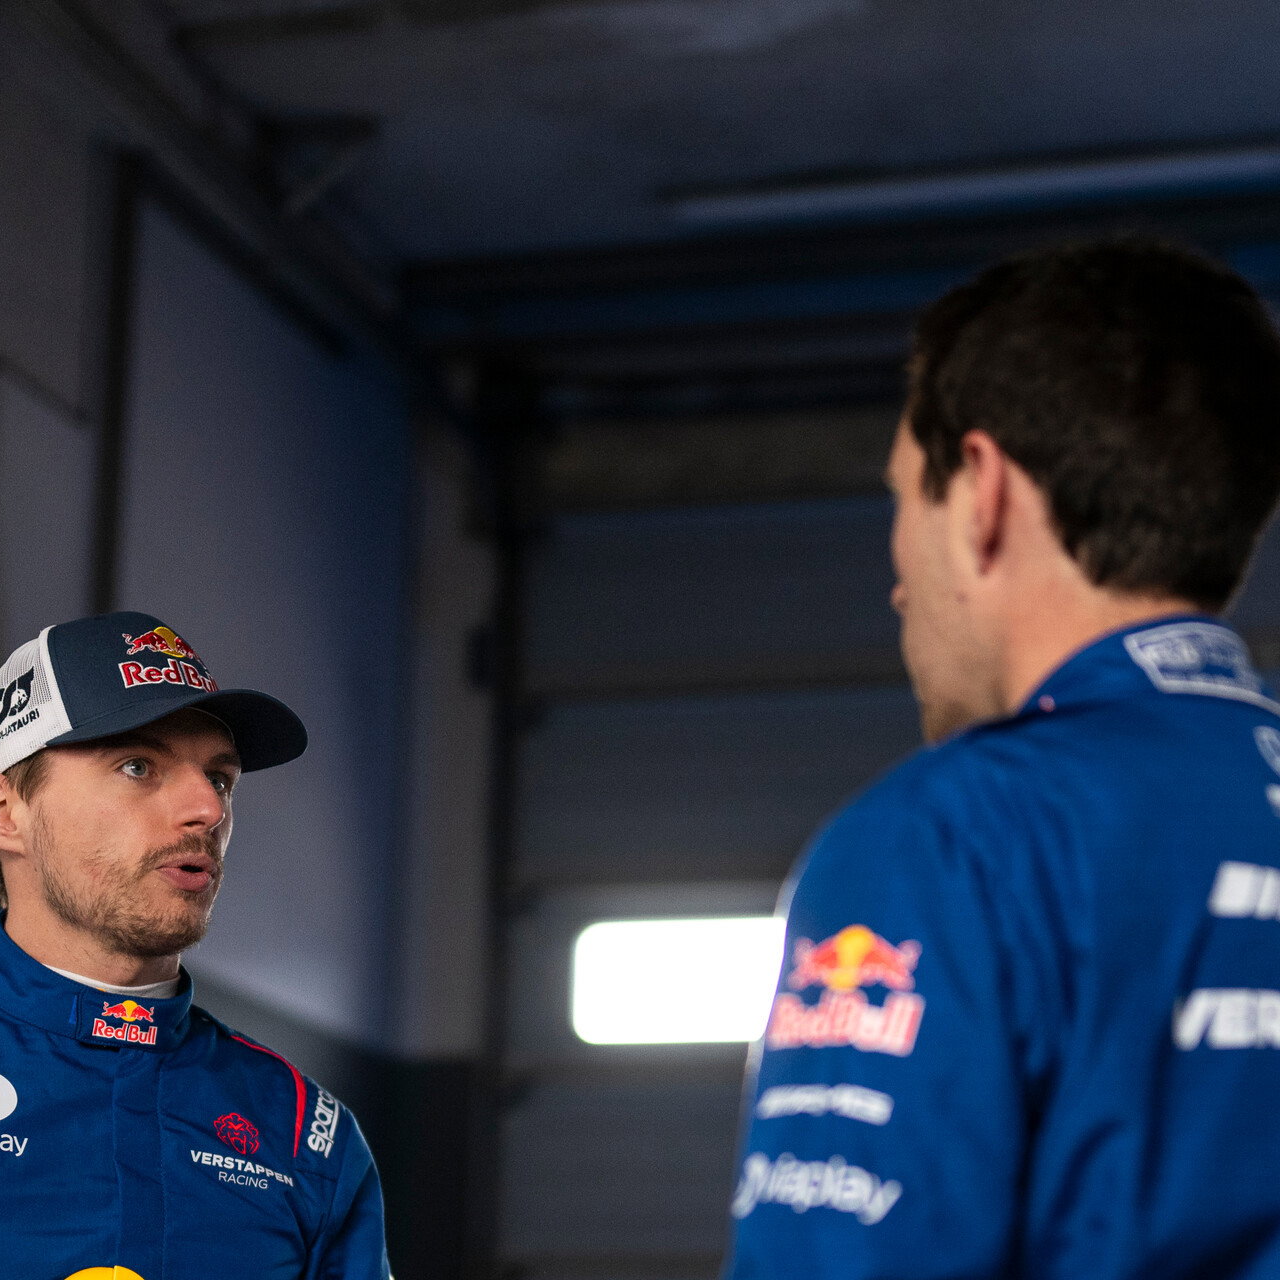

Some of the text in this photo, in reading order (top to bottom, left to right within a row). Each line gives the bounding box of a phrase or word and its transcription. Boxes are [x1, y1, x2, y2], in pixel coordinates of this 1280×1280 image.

[118, 658, 185, 689] Red
[92, 1018, 158, 1045] Red Bull
[190, 1150, 294, 1187] VERSTAPPEN
[218, 1171, 269, 1189] RACING
